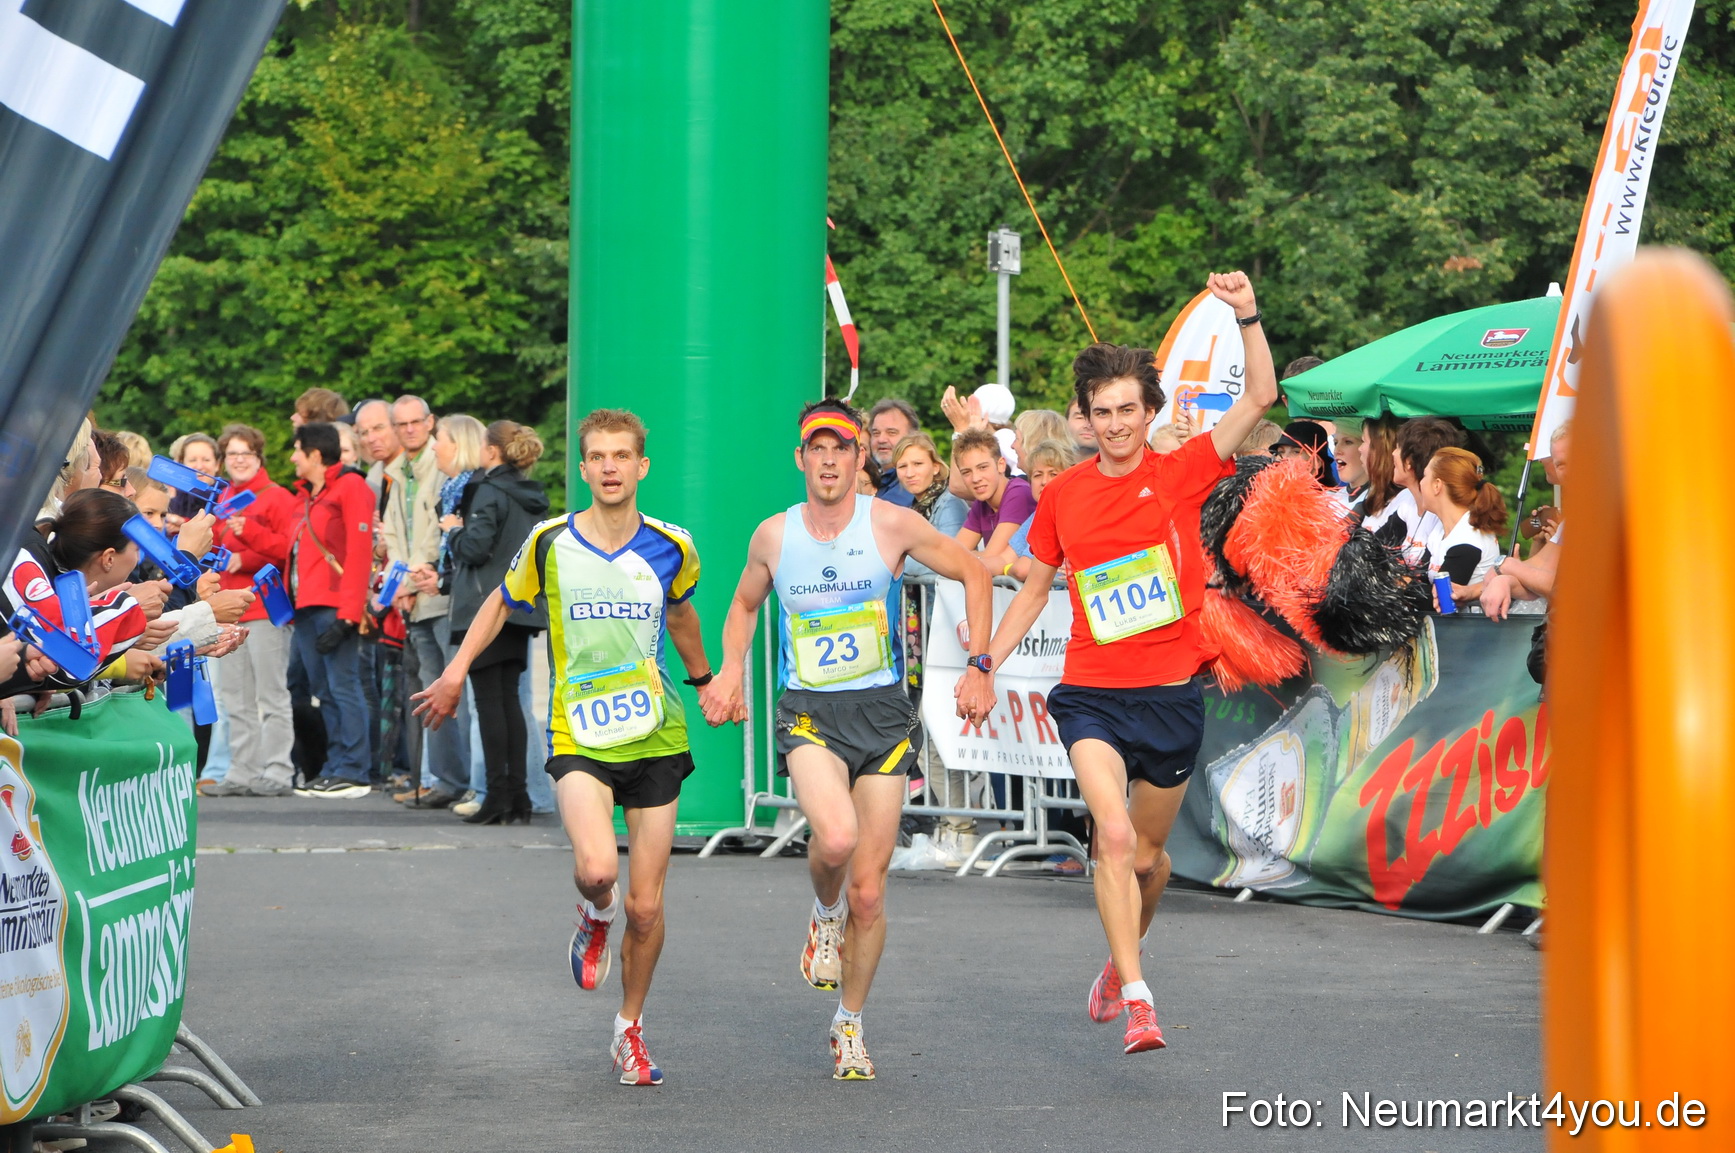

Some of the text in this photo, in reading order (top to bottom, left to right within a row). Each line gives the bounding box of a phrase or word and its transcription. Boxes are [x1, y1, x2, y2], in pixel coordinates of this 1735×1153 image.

[1441, 349, 1548, 361] Neumarkter
[570, 588, 624, 600] TEAM
[789, 579, 873, 596] SCHABMÜLLER
[1090, 575, 1168, 622] 1104
[570, 602, 653, 621] BOCK
[1114, 615, 1138, 628] Lukas
[814, 632, 860, 668] 23
[822, 665, 847, 675] Marco
[571, 689, 652, 731] 1059
[594, 726, 625, 738] Michael
[78, 742, 195, 876] Neumarkter
